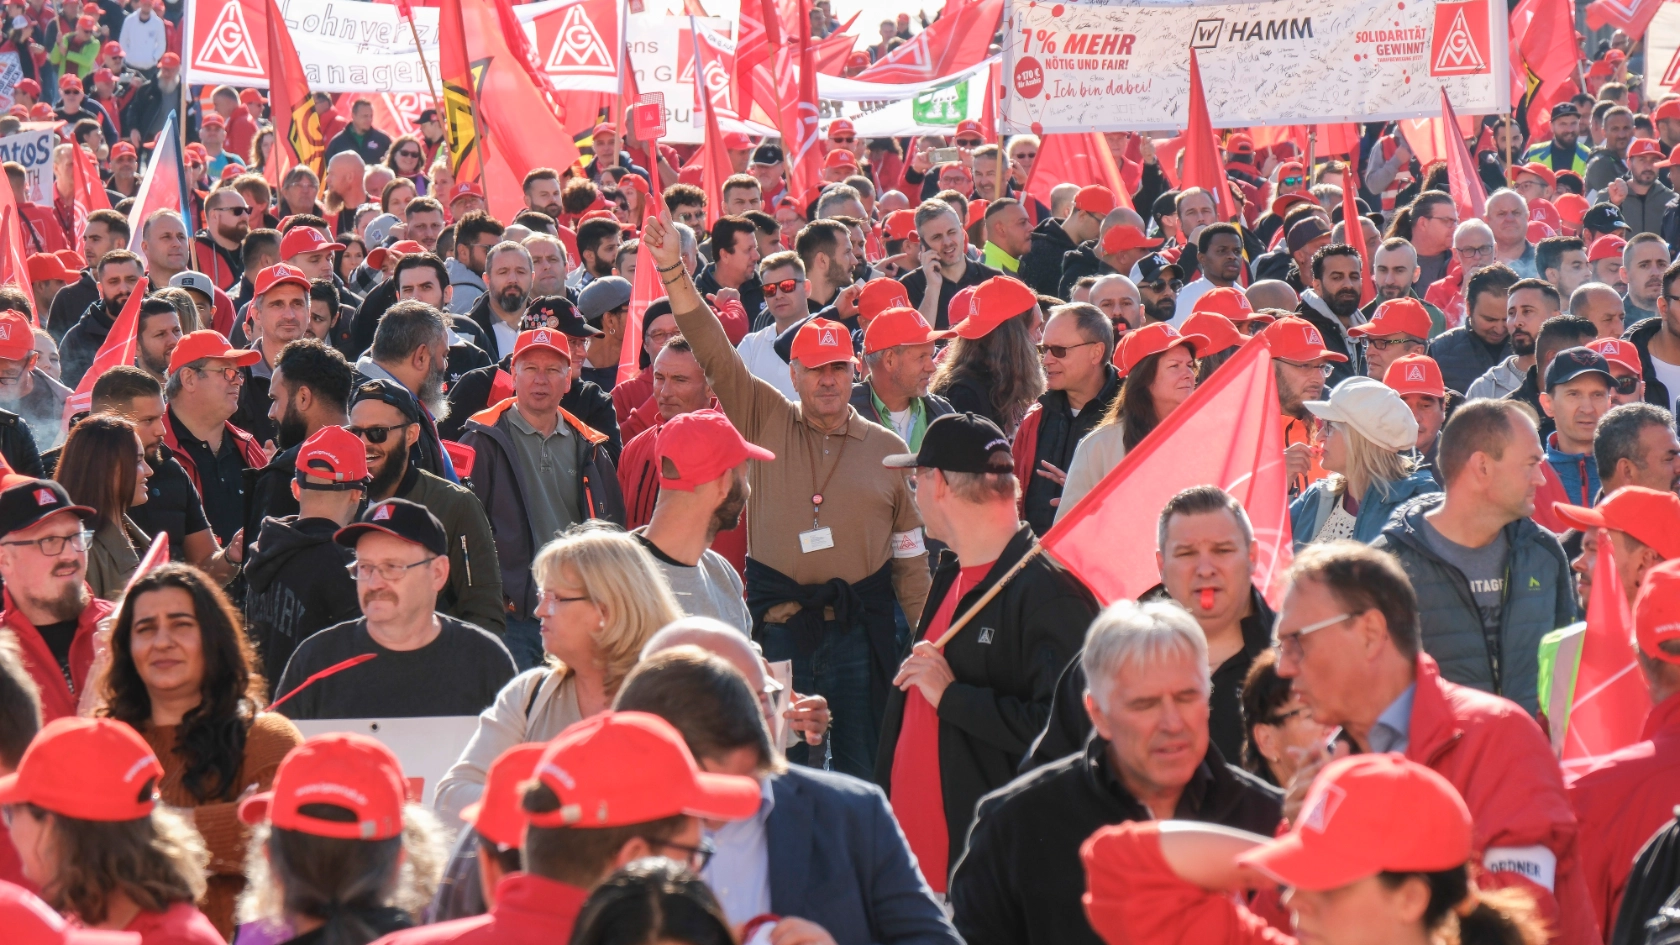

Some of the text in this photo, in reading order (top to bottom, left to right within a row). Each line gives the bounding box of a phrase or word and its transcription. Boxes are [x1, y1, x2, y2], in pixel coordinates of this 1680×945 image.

[1228, 17, 1314, 42] HAMM
[1355, 25, 1427, 44] SOLIDARITÄT
[1063, 33, 1137, 55] MEHR
[1376, 41, 1425, 56] GEWINNT
[1045, 56, 1129, 70] NÖTIG UND FAIR!
[1053, 76, 1153, 99] Ich bin dabei!
